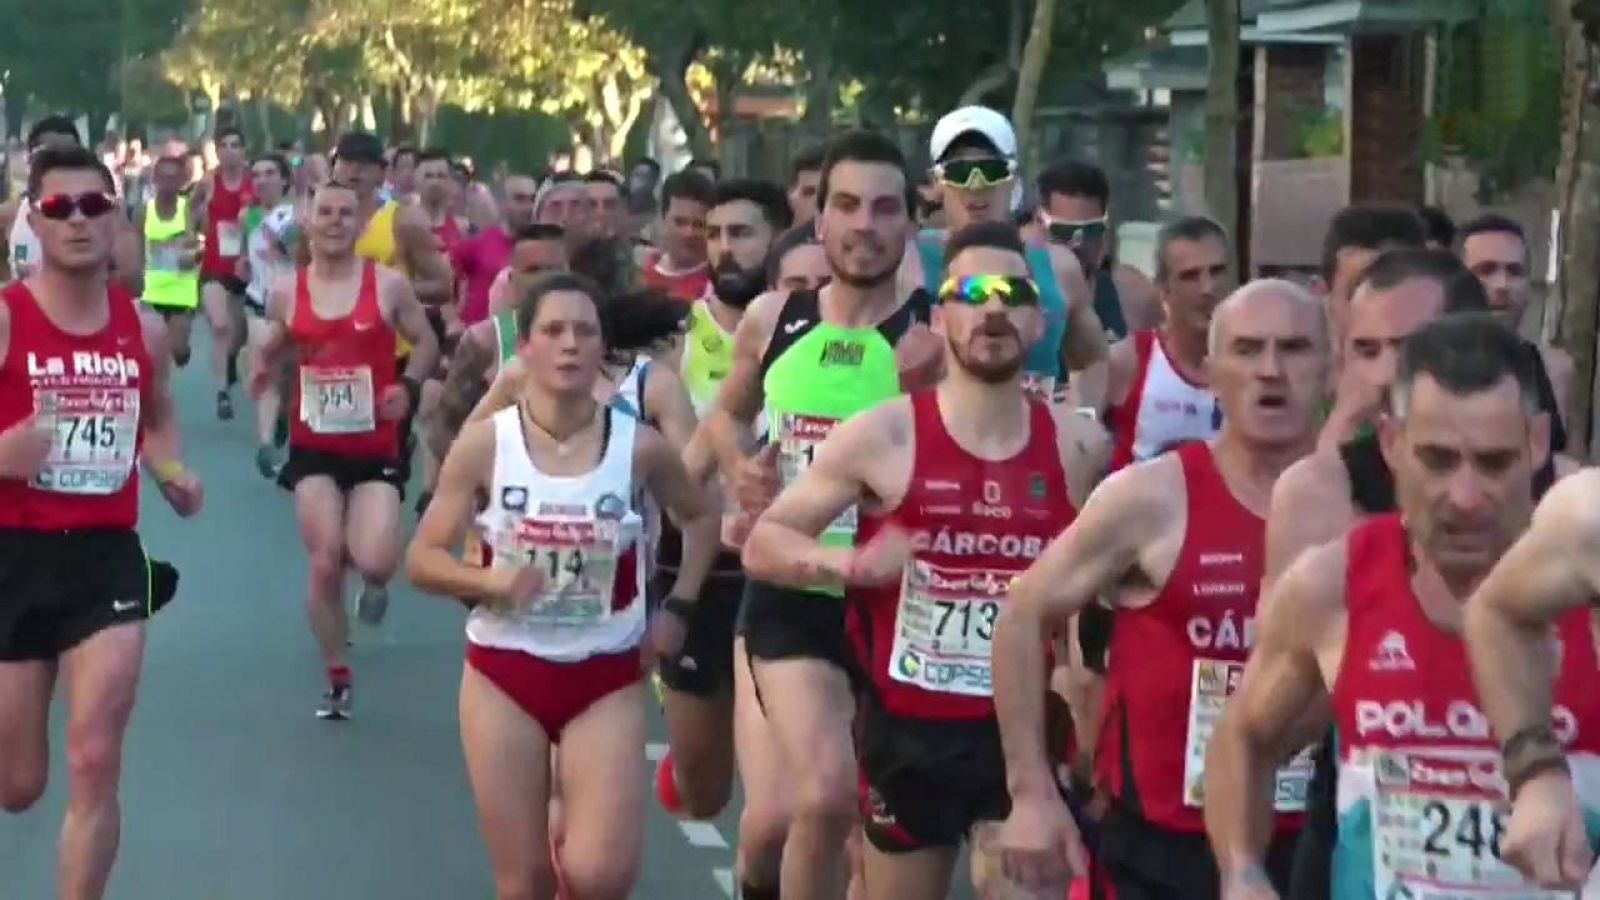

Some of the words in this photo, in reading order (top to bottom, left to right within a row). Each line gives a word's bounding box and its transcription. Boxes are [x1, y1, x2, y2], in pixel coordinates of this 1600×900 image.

[27, 351, 64, 376] La
[73, 350, 139, 385] Rioja
[60, 415, 116, 447] 745
[934, 600, 999, 641] 713
